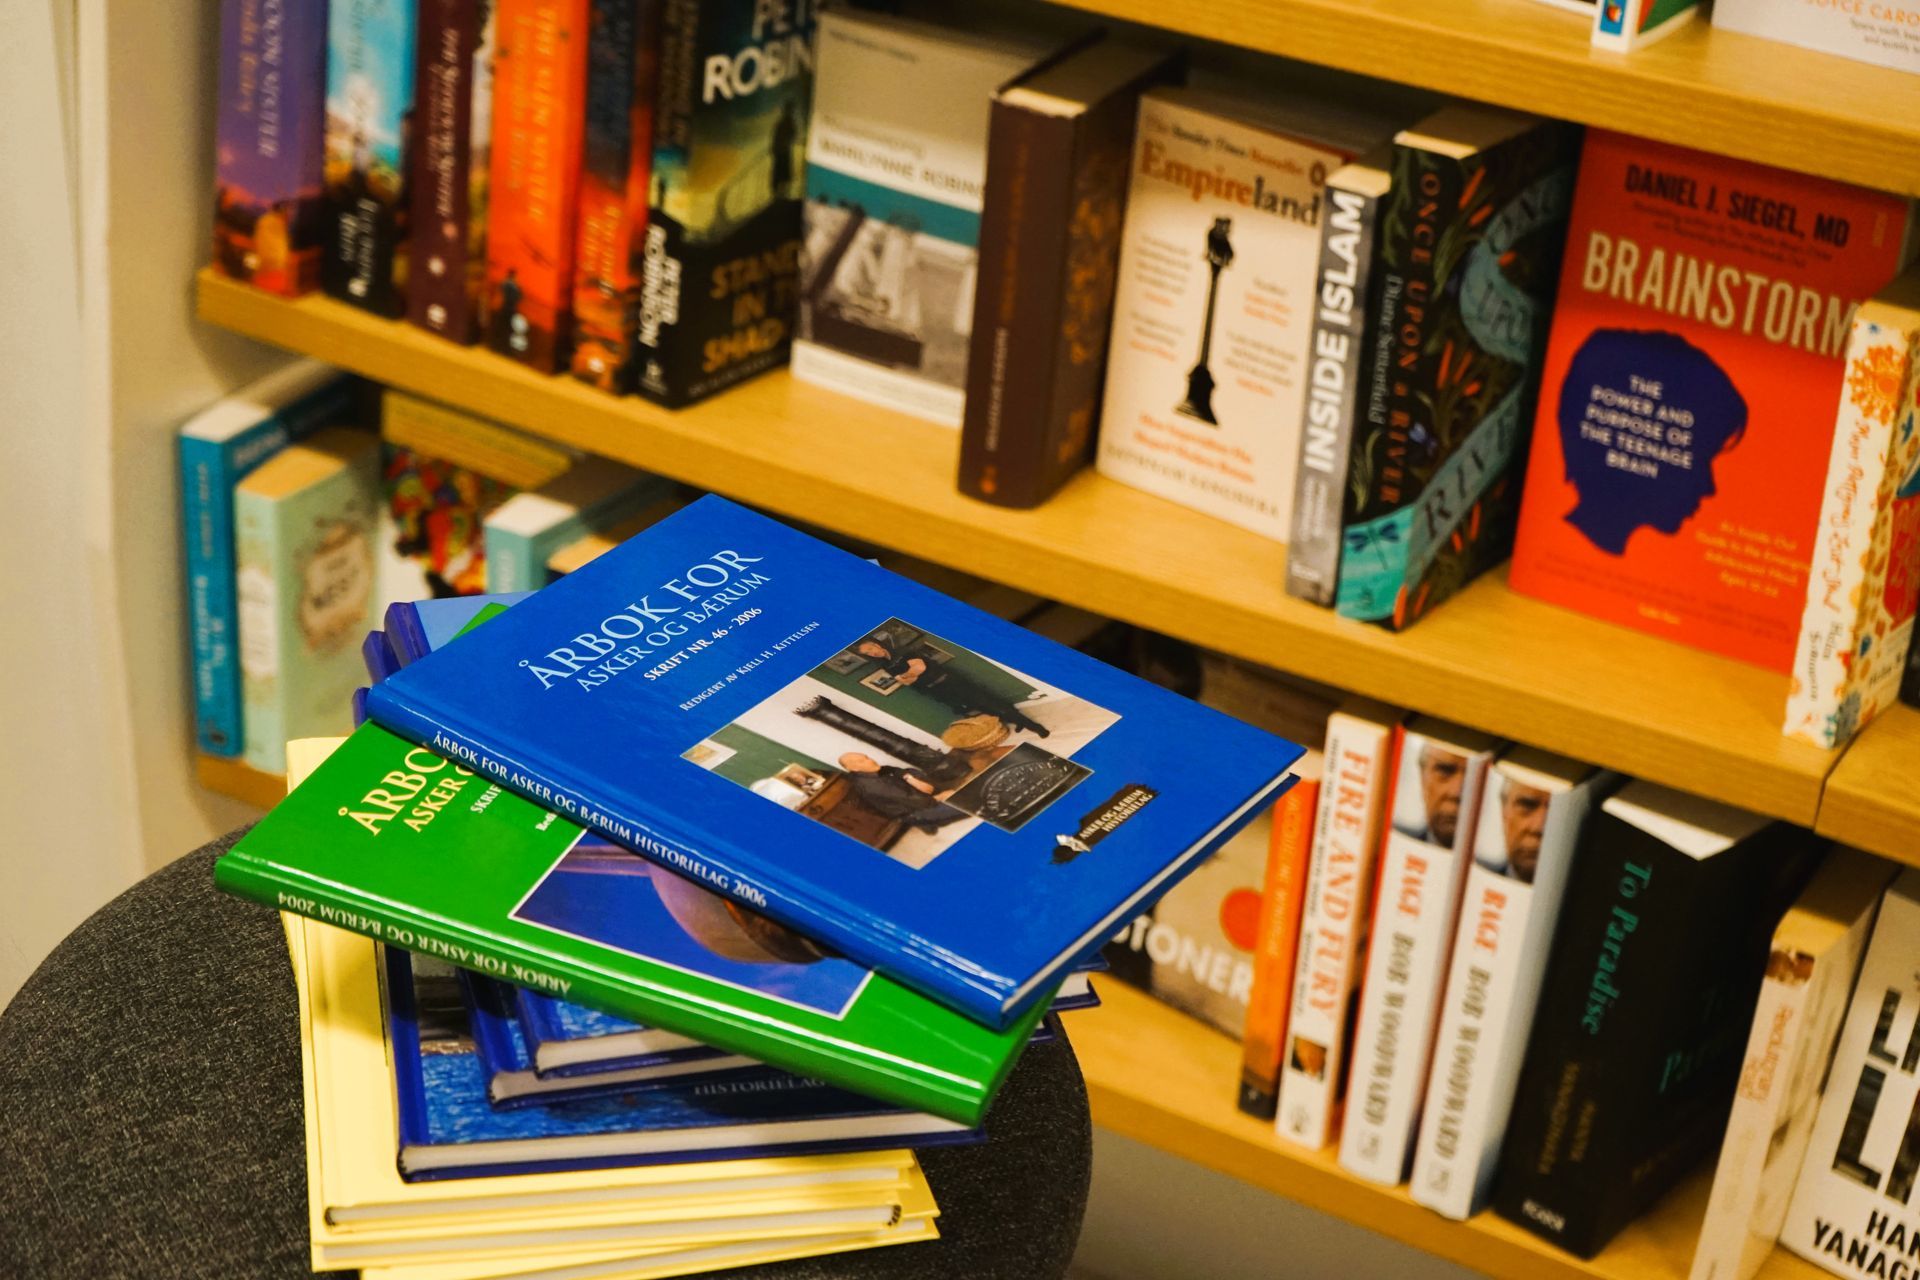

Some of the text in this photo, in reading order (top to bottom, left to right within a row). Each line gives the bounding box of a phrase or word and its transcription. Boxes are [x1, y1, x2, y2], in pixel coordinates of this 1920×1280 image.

[1141, 138, 1321, 228] Empireland
[1409, 172, 1441, 265] ONCE
[1624, 163, 1699, 211] DANIEL
[1813, 212, 1851, 249] MD
[1319, 191, 1366, 326] ISLAM
[1582, 231, 1862, 359] BRAINSTORM
[1397, 279, 1428, 372] UPON
[1303, 329, 1350, 474] INSIDE
[1585, 402, 1693, 448] PURPOSE OF
[1591, 384, 1695, 429] POWER AND
[1629, 373, 1663, 400] THE
[1580, 421, 1693, 470] THE TEENAGE
[1605, 448, 1659, 480] BRAIN
[518, 550, 764, 690] ÅRBOK FOR
[576, 572, 771, 692] ASKER OG BÆRUM
[643, 649, 689, 681] SKRIFT
[711, 627, 729, 642] 46
[734, 606, 762, 627] 2006
[338, 747, 449, 836] ÅRBO
[403, 776, 468, 832] ASKER
[432, 730, 478, 766] ÅRBOK
[481, 756, 508, 780] FOR
[510, 772, 552, 801] ASKER
[554, 794, 577, 813] OG
[580, 805, 631, 841] BÆRUM
[635, 832, 729, 890] HISTORIELAG
[732, 879, 768, 909] 2006
[470, 783, 502, 814] SKRIF
[277, 891, 316, 912] 2004
[319, 903, 382, 936] BÆRUM
[1308, 748, 1371, 1020] FIRE AND FURY
[387, 924, 414, 944] OG
[417, 934, 470, 966] ASKER
[473, 950, 508, 976] FOR
[1581, 858, 1654, 1036] To Paradise
[1364, 853, 1428, 1127] RAGE BOB WOODWARD
[1434, 888, 1507, 1161] RAGE BOB WOODWARD
